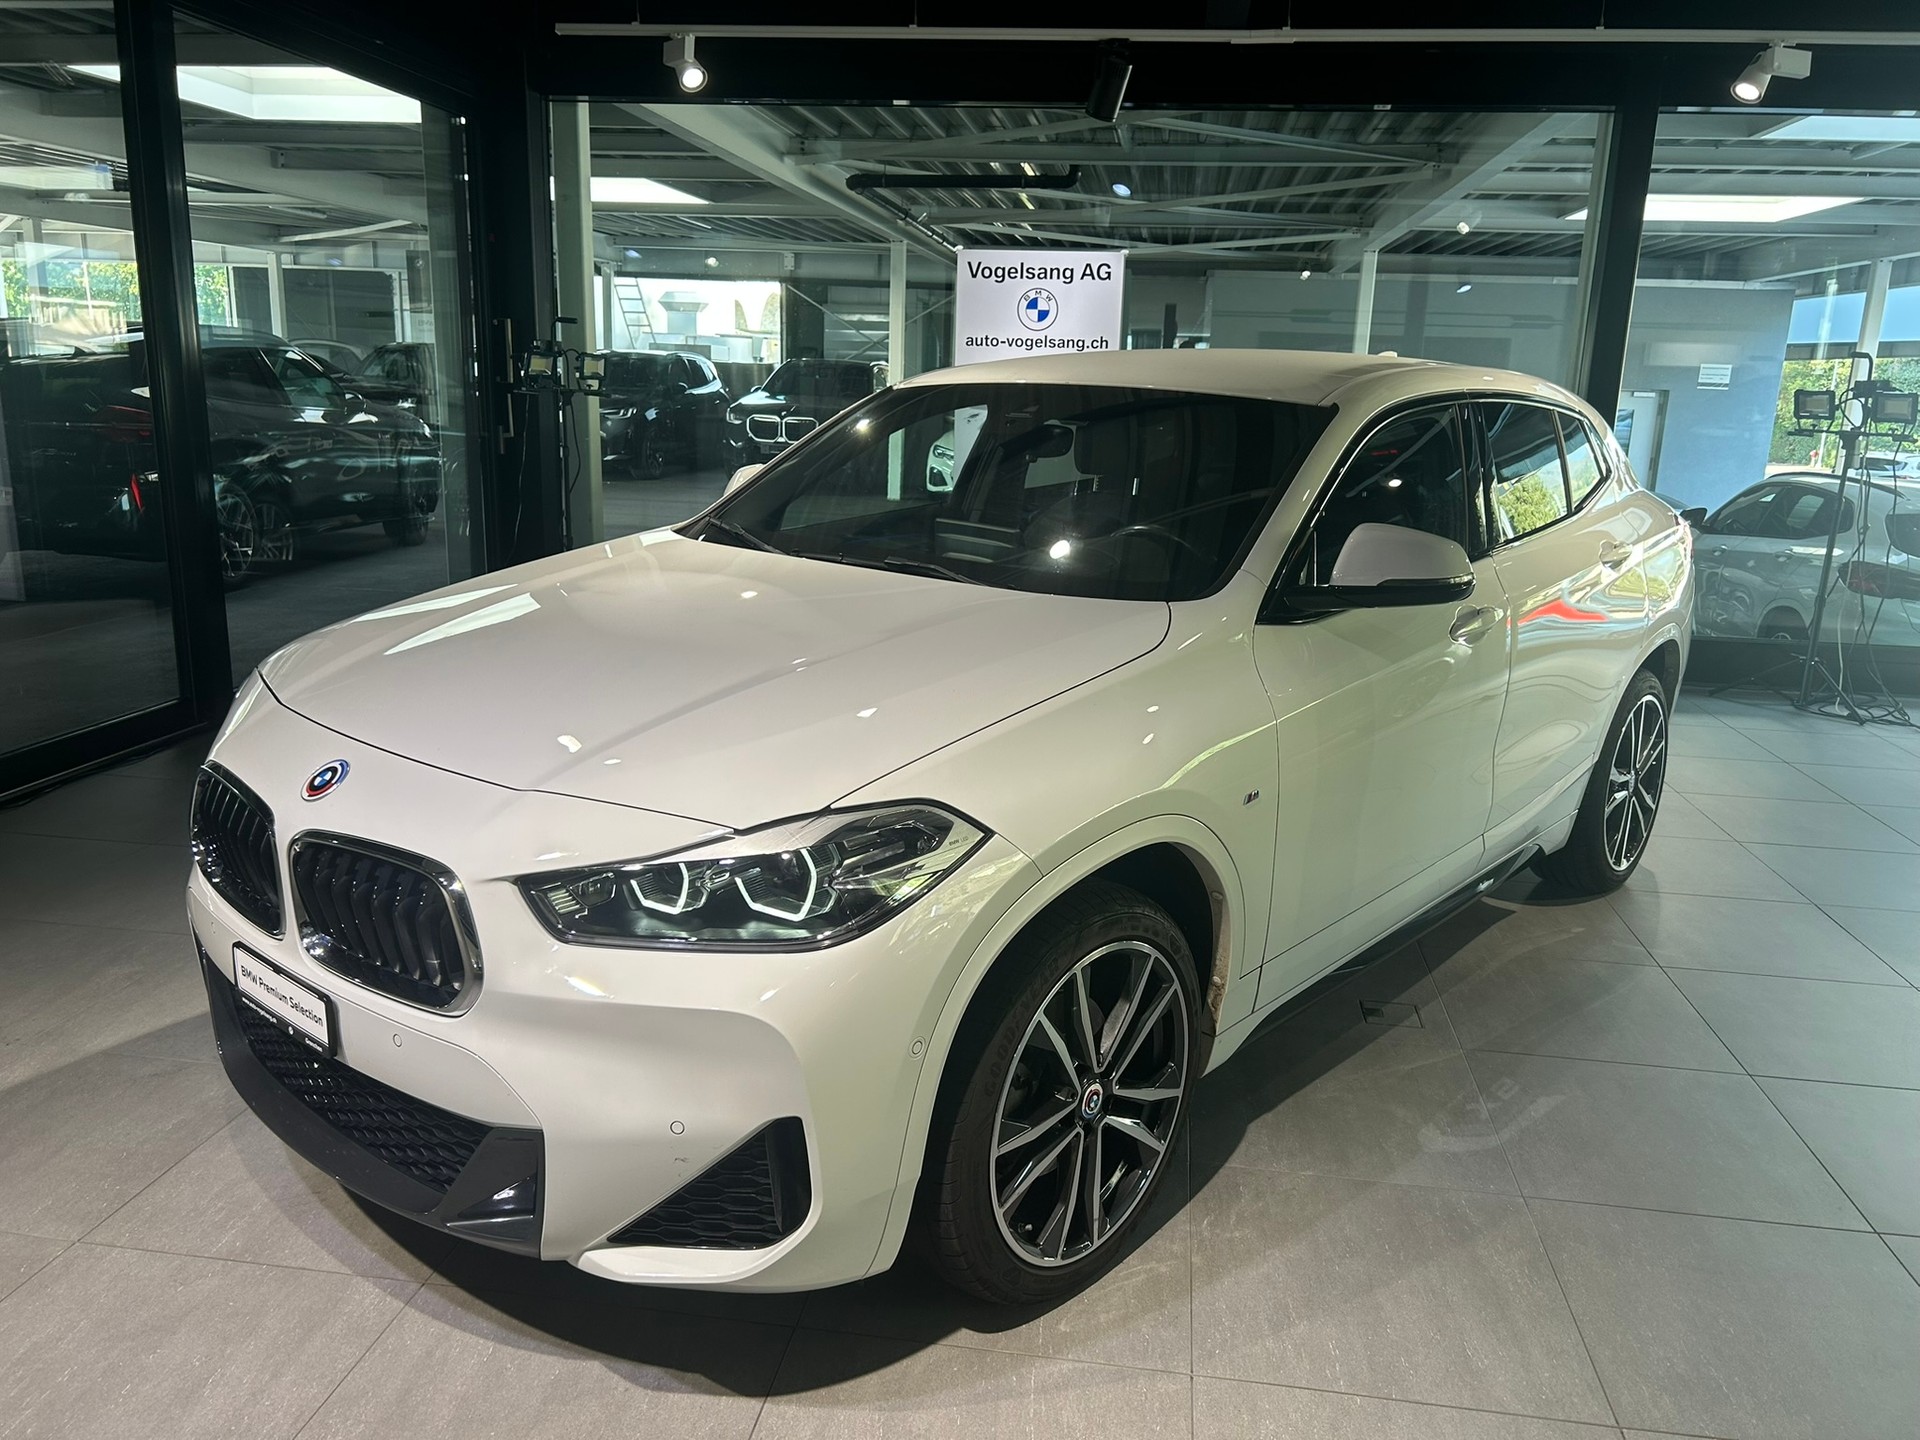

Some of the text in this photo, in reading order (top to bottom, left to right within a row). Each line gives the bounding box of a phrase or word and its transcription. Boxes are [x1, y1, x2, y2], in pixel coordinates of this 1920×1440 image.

[967, 261, 1112, 284] Vogelsang AG
[965, 335, 1109, 352] auto-vogelsang.ch
[241, 965, 258, 986] BMW
[258, 976, 289, 1007] Premium
[289, 996, 324, 1027] Selection
